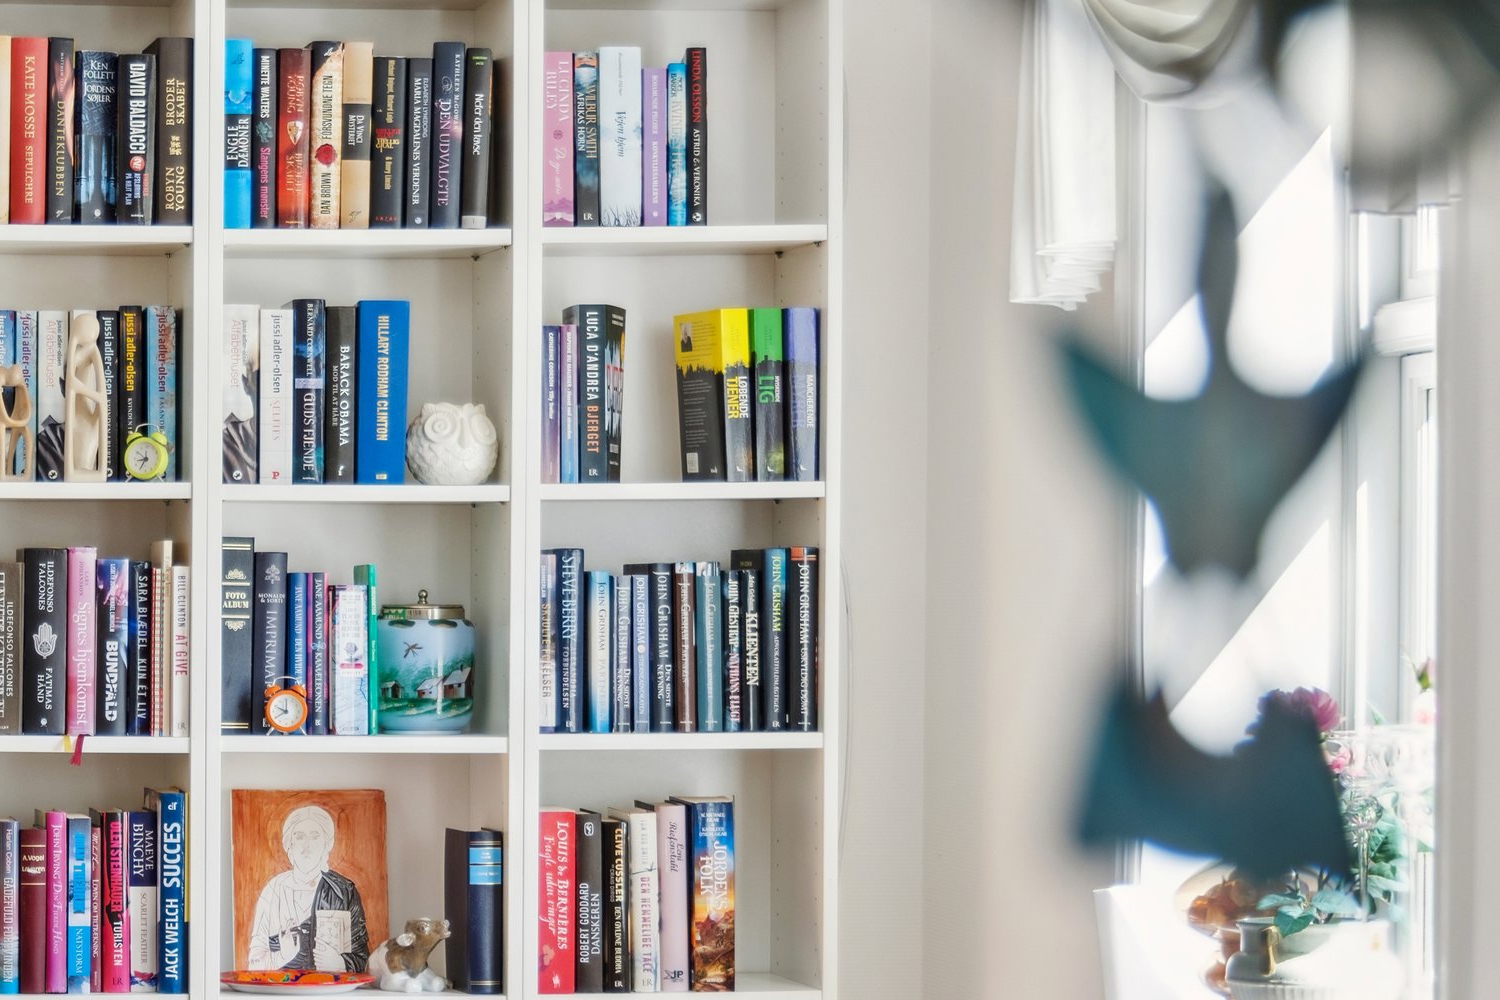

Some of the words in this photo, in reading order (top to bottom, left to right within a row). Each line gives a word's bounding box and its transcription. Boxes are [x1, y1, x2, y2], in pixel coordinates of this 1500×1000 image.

[25, 56, 34, 89] KATE
[130, 63, 145, 96] DAVID
[261, 56, 270, 84] MINETTE
[692, 51, 700, 80] LINDA
[260, 87, 270, 118] WALTERS
[414, 78, 422, 104] MARIA
[586, 85, 596, 123] WILBUR
[692, 84, 700, 122] OLSSON
[25, 94, 34, 138] MOSSE
[130, 101, 146, 154] BALDACCI
[437, 99, 452, 129] DEN
[56, 101, 65, 196] DANTEKLUBBEN
[413, 107, 422, 160] MAGDALENES
[586, 128, 596, 159] SMITH
[25, 146, 33, 203] SEPULCHRE
[260, 147, 271, 182] Slangens
[412, 163, 421, 204] VERDENER
[438, 133, 449, 206] UDVALGTE
[260, 185, 270, 218] mønster
[125, 313, 136, 336] jussi
[378, 316, 389, 354] HILLARY
[587, 312, 598, 339] LUCA
[126, 337, 136, 391] adler-olsen
[339, 346, 349, 396] BARACK
[377, 357, 388, 398] RODHAM
[587, 345, 598, 400] D'ANDREA
[332, 396, 338, 405] AT
[727, 376, 739, 418] TJENER
[738, 376, 748, 418] LØBENDE
[758, 375, 774, 404] LIG
[339, 400, 349, 446] OBAMA
[376, 400, 388, 441] CLINTON
[587, 405, 599, 453] BJERGET
[138, 576, 147, 602] SARA
[177, 576, 186, 593] BILL
[314, 579, 322, 598] JANE
[561, 557, 575, 596] STEVE
[656, 571, 670, 600] JOHN
[73, 602, 91, 645] Signes
[138, 607, 147, 649] BLÆDEL
[177, 596, 185, 627] CLINTON
[314, 601, 322, 639] AAMUND
[563, 600, 575, 641] BERRY
[175, 635, 187, 647] AT
[658, 604, 670, 658] GRISHAM
[746, 612, 758, 686] KLIENTEN
[138, 658, 147, 679] KUN
[175, 651, 187, 676] GIVE
[37, 675, 46, 703] HÅND
[73, 650, 92, 725] hjemkomst
[137, 686, 149, 696] ÉT
[137, 702, 146, 719] LIV
[133, 823, 144, 876] BINCHY
[145, 830, 154, 870] MAEVE
[164, 823, 180, 887] SUCCES
[700, 856, 713, 895] FOLK
[714, 842, 727, 909] JORDENS
[92, 902, 98, 912] OM
[165, 899, 178, 944] WELCH
[579, 883, 588, 925] GODDARD
[591, 894, 600, 954] DANSKEREN
[75, 929, 83, 973] NATSTORM
[165, 949, 178, 980] JACK
[580, 929, 589, 962] ROBERT
